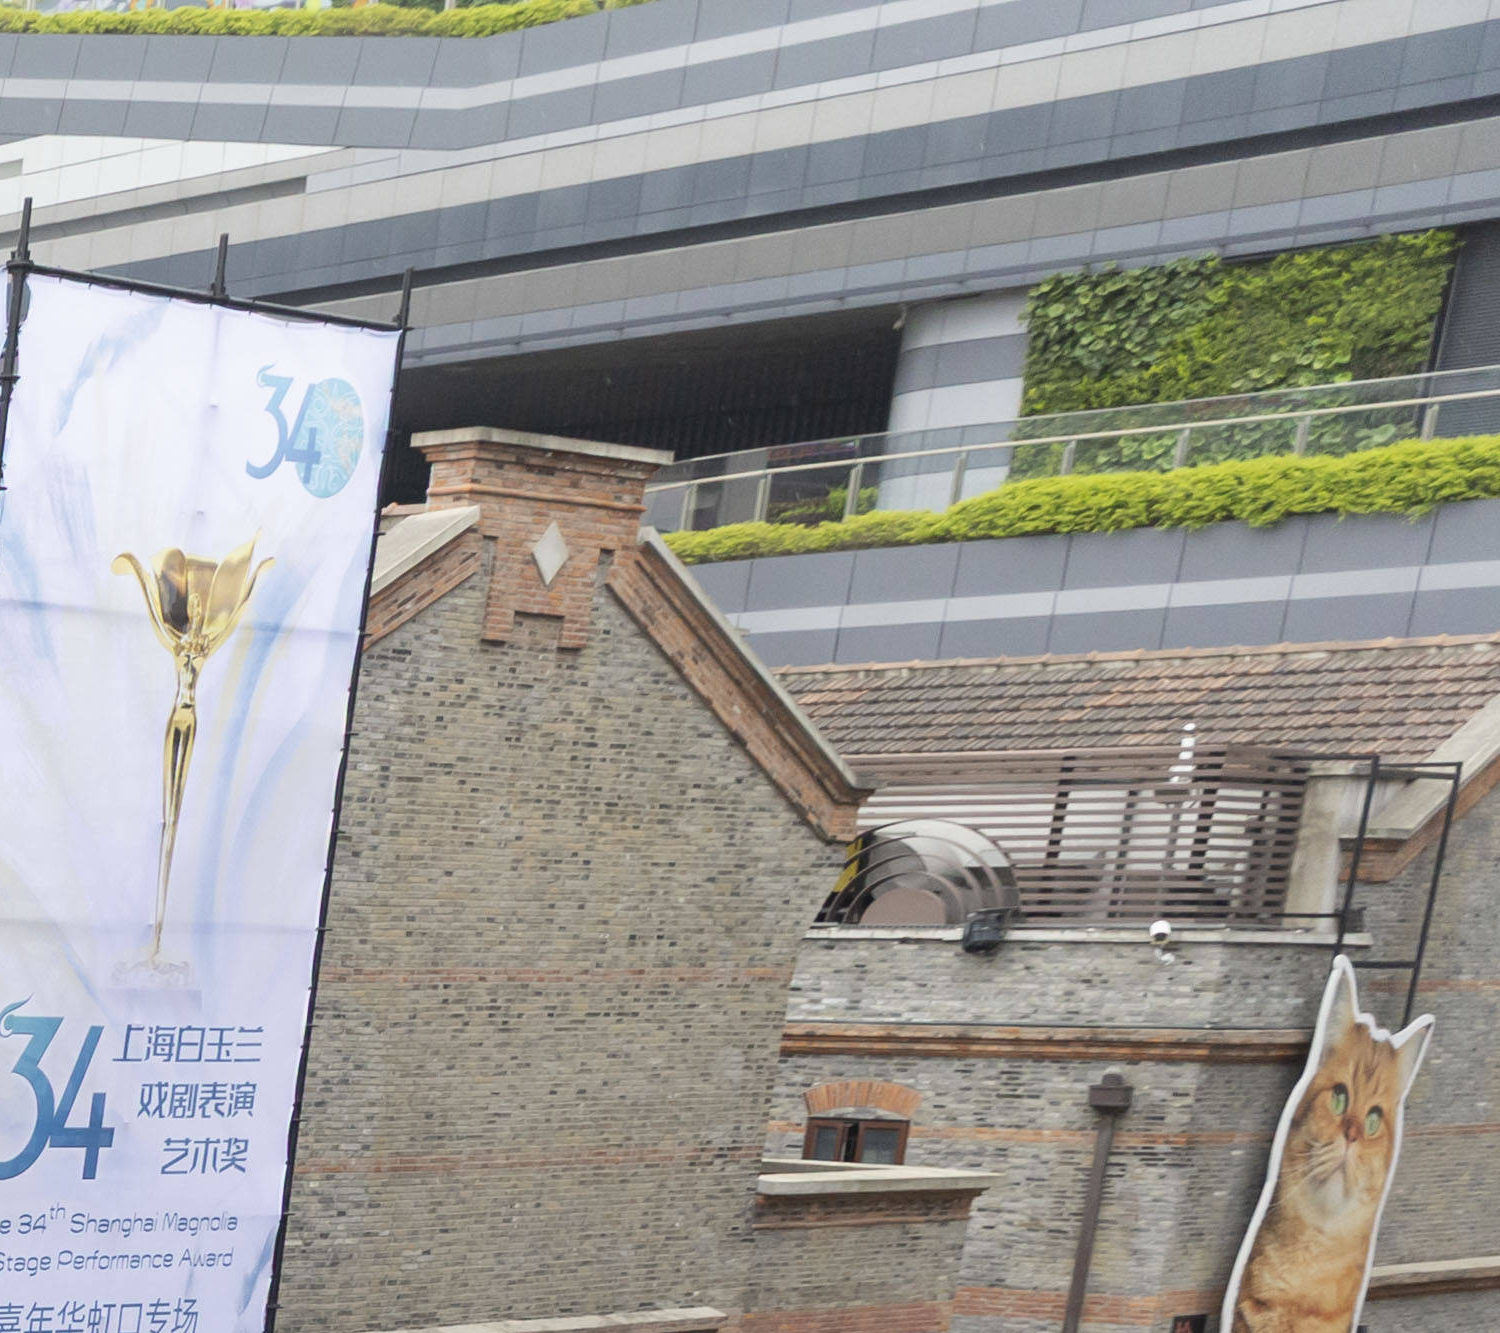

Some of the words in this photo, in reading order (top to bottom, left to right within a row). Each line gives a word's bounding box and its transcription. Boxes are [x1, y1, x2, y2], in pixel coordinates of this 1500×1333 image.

[112, 1025, 264, 1062] 上海白玉兰
[137, 1081, 257, 1119] 戏剧表演
[161, 1137, 249, 1174] 艺术奖
[70, 1212, 157, 1238] Shanghai
[162, 1212, 238, 1236] Magnolia
[56, 1249, 173, 1271] Performance
[179, 1248, 235, 1268] Award
